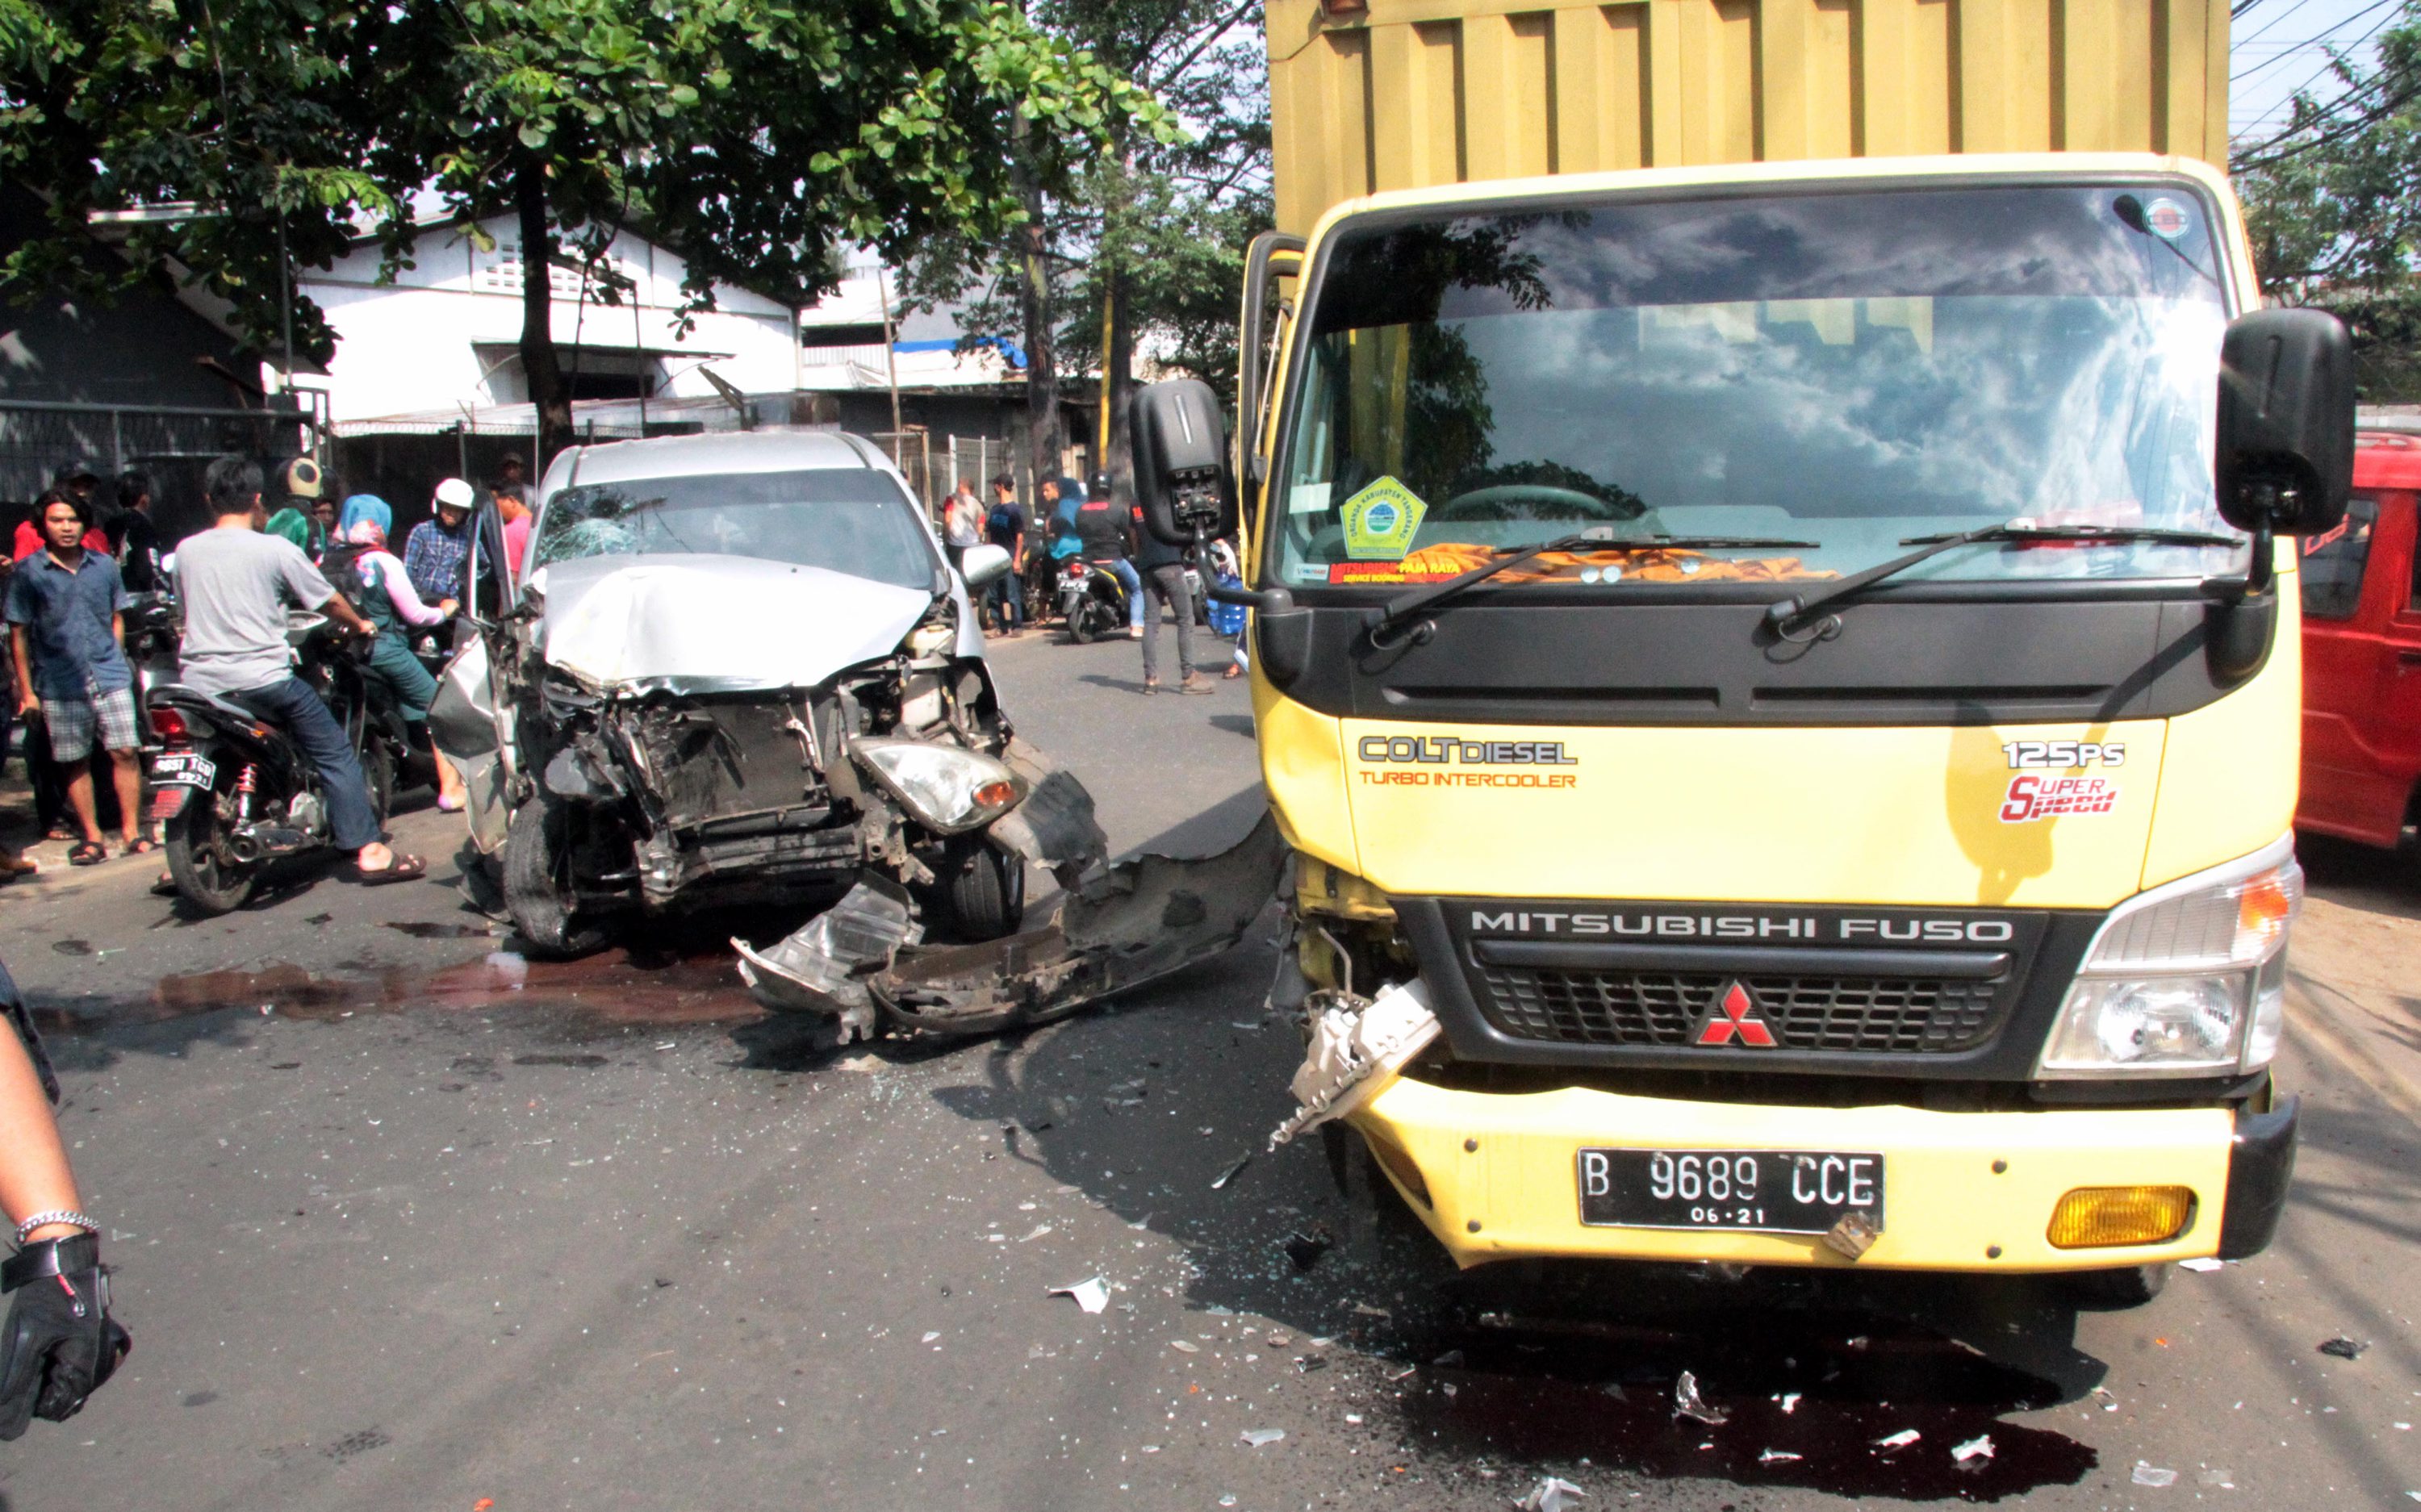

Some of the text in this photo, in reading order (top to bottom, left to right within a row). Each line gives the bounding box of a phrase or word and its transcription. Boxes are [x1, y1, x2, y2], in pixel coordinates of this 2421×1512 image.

[1361, 488, 1402, 503] KABUPATEN
[1399, 497, 1413, 539] TANGERANG
[1343, 574, 1370, 583] SERVICE
[1399, 562, 1428, 574] PAJA
[1429, 562, 1460, 574] RAYA
[2001, 741, 2125, 768] 125PS
[1359, 771, 1576, 787] TURBO INTERCOOLER
[1471, 912, 2012, 942] MITSUBISHI FUSO
[1585, 1152, 1873, 1205] B 9689 CCE
